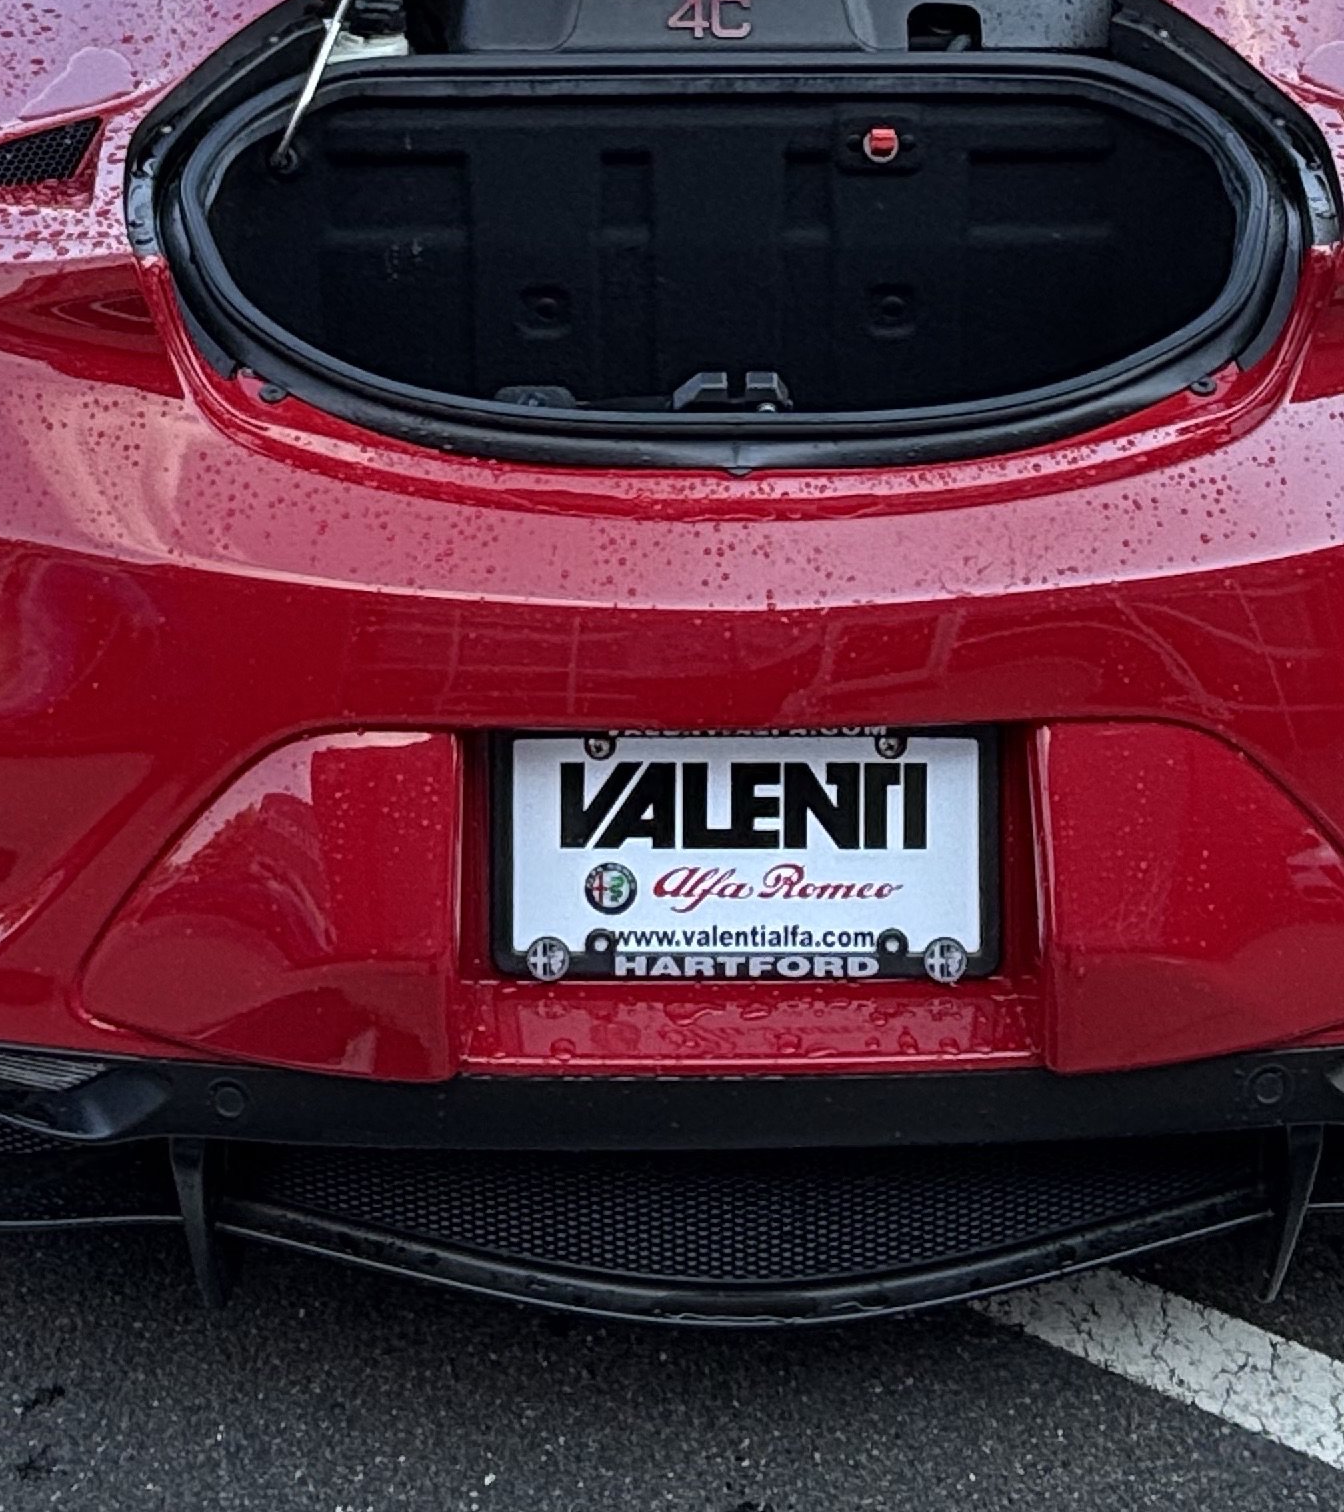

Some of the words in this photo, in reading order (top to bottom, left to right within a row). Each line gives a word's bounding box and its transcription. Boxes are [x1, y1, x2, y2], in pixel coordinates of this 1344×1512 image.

[560, 762, 927, 849] VALENTI
[652, 865, 754, 913] Alfa
[757, 863, 903, 899] Romeo
[614, 925, 875, 948] www.valentialfa.com
[614, 955, 880, 977] HARTFORD
